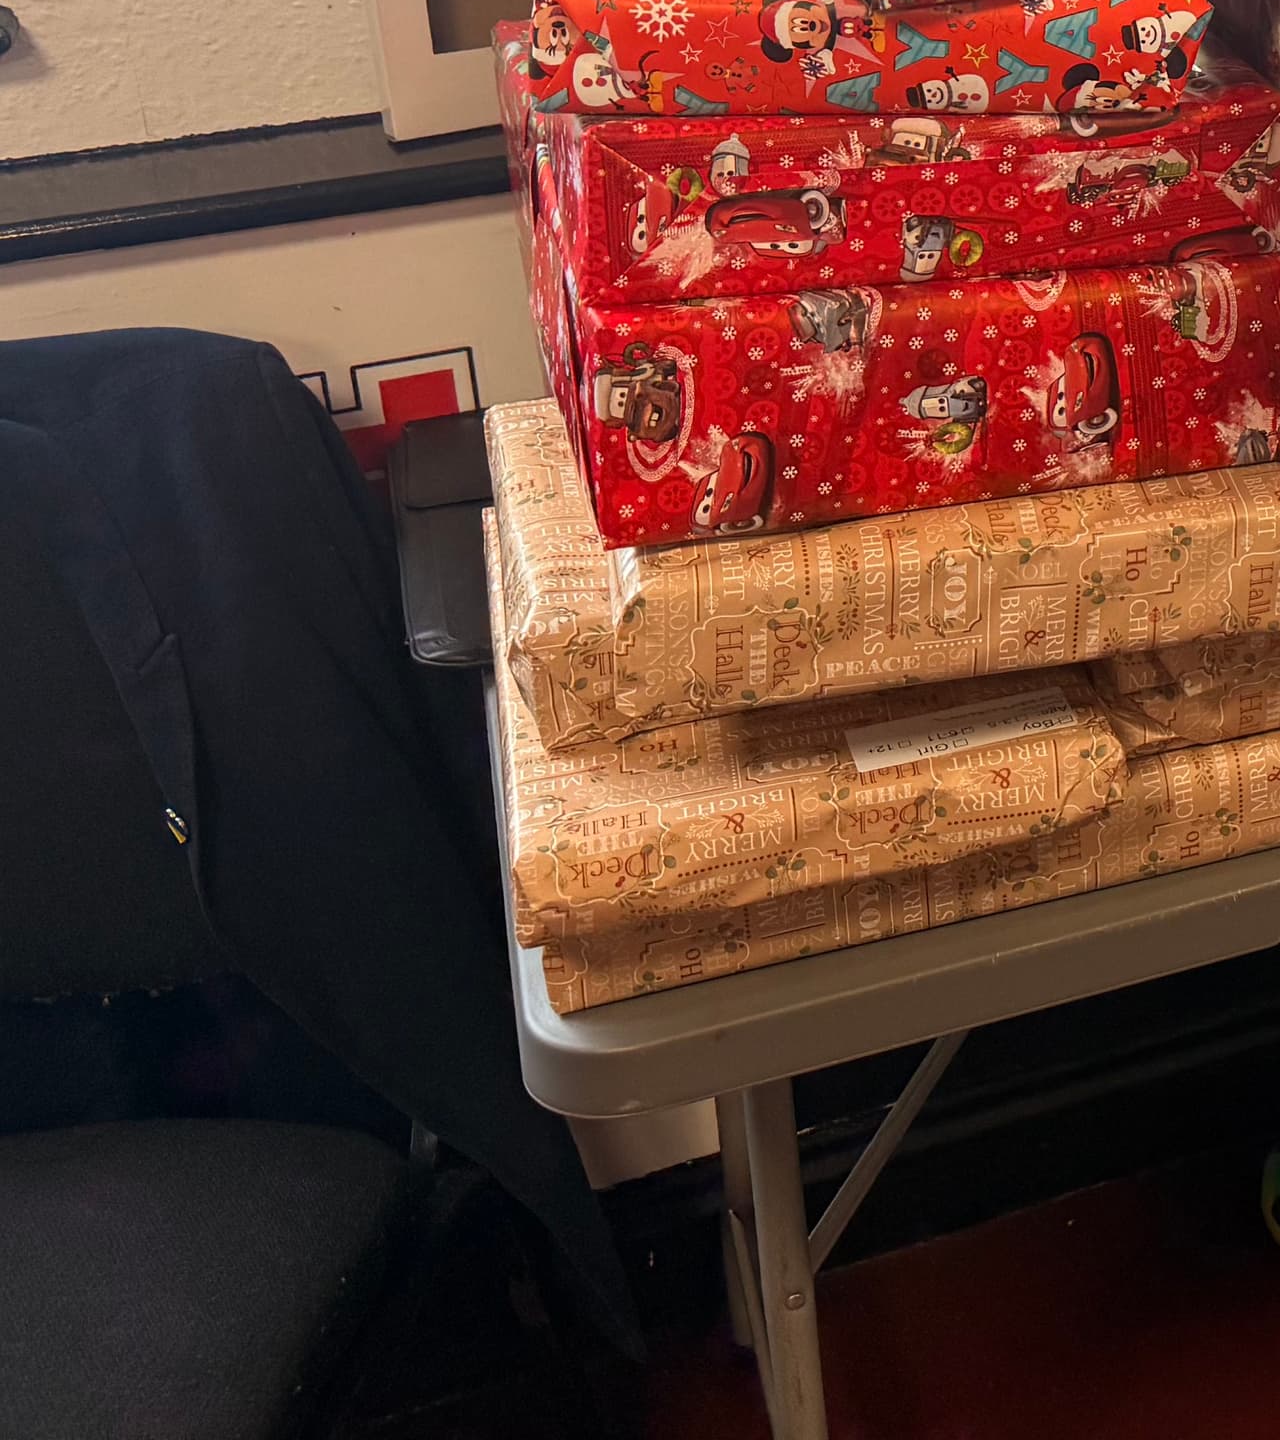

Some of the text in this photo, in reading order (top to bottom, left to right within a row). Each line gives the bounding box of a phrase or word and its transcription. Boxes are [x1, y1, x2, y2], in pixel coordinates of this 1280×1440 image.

[815, 534, 835, 603] WISHES
[897, 538, 922, 620] MERRY
[1004, 563, 1068, 583] NOEL
[1125, 546, 1148, 582] Ho
[858, 525, 886, 656] CHRISTMAS
[943, 561, 967, 625] JOY
[1248, 561, 1275, 627] Halls
[1025, 630, 1046, 648] &
[715, 625, 745, 700] Halls
[750, 628, 768, 686] THE
[771, 621, 801, 690] Deck
[826, 655, 920, 679] PEACE
[640, 738, 679, 753] Ho
[868, 741, 895, 754] 12+
[917, 716, 1051, 756] Boy Girl
[928, 727, 961, 742] 6-11
[947, 740, 1050, 771] BRIGHT
[991, 768, 1012, 789] &
[676, 788, 785, 820] BRIGHT
[855, 783, 917, 807] THE
[955, 782, 1047, 813] MERRY
[565, 811, 648, 837] Halls
[721, 812, 745, 834] &
[849, 802, 921, 835] Deck
[938, 823, 1026, 845] WISHES
[575, 830, 647, 857] THE
[685, 827, 784, 864] MERRY
[1181, 830, 1200, 860] Ho
[569, 849, 651, 888] Deck
[669, 867, 763, 899] WISHES
